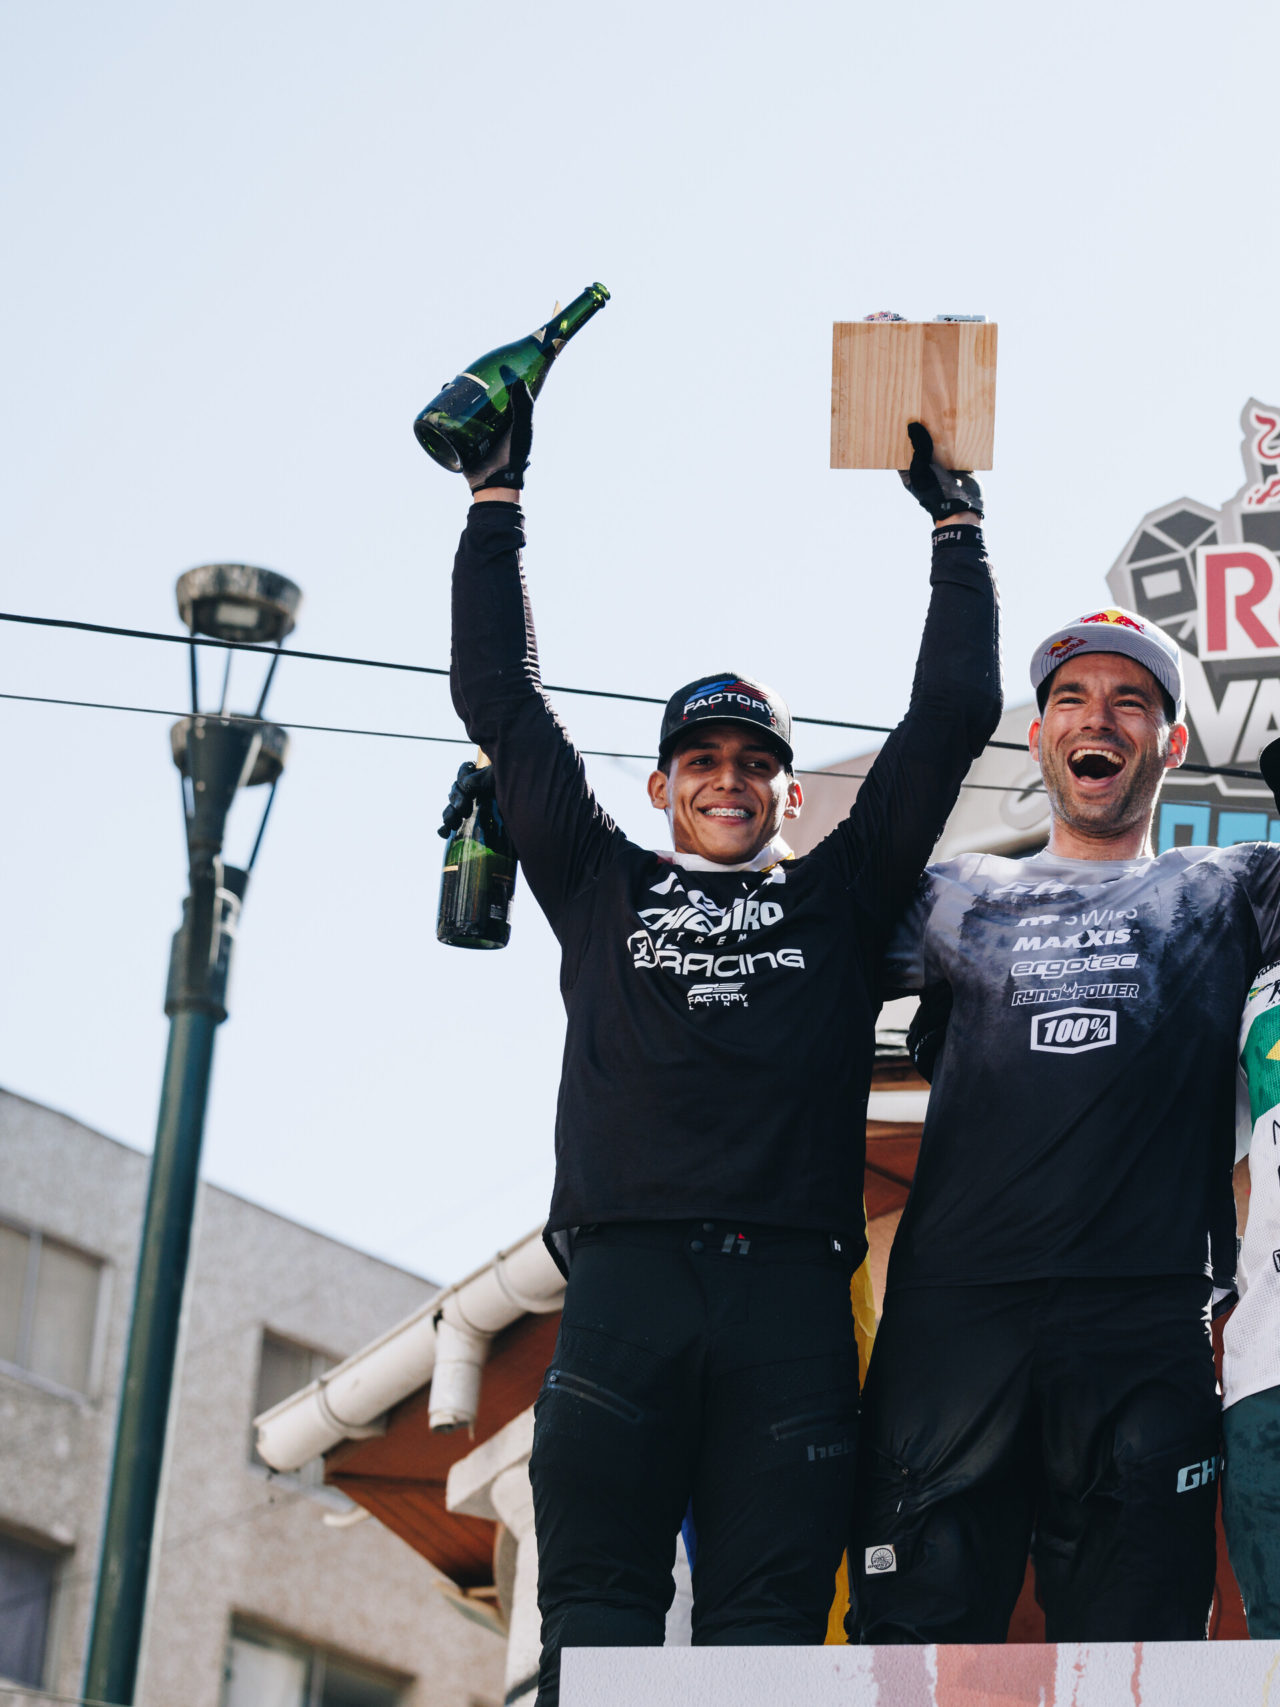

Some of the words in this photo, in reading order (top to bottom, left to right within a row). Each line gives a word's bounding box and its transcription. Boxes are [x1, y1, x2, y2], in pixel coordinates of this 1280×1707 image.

[683, 692, 776, 716] FACTORY
[1012, 928, 1133, 952] MAXXIS
[656, 948, 806, 977] RACING
[1011, 953, 1139, 980] ergotec
[688, 993, 748, 1005] FACTORY
[1072, 983, 1139, 1001] POWER
[688, 1001, 749, 1010] LINE
[1043, 1017, 1109, 1044] 100%
